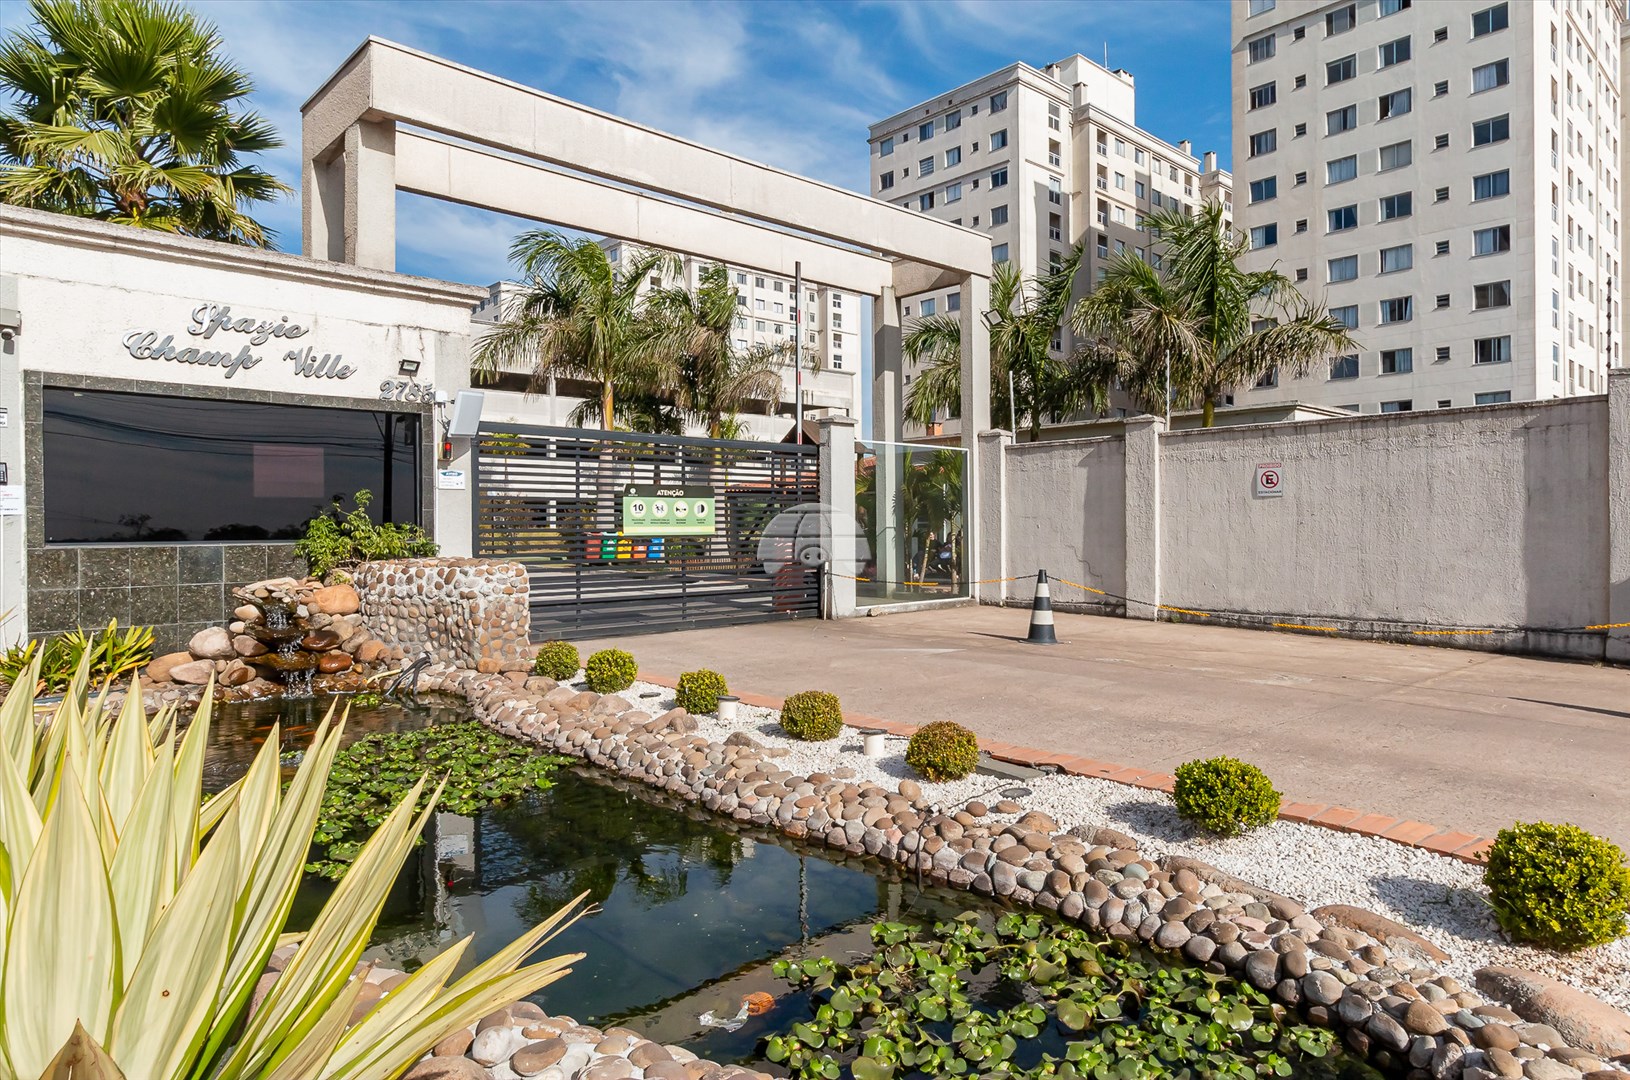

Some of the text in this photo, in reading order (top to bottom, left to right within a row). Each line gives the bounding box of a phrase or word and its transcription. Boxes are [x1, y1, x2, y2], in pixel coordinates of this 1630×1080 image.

[187, 303, 309, 346] Spazio
[122, 327, 358, 379] Champ Ville
[378, 380, 435, 404] 2785
[656, 488, 684, 497] ATENÇÃO
[633, 503, 644, 512] 10
